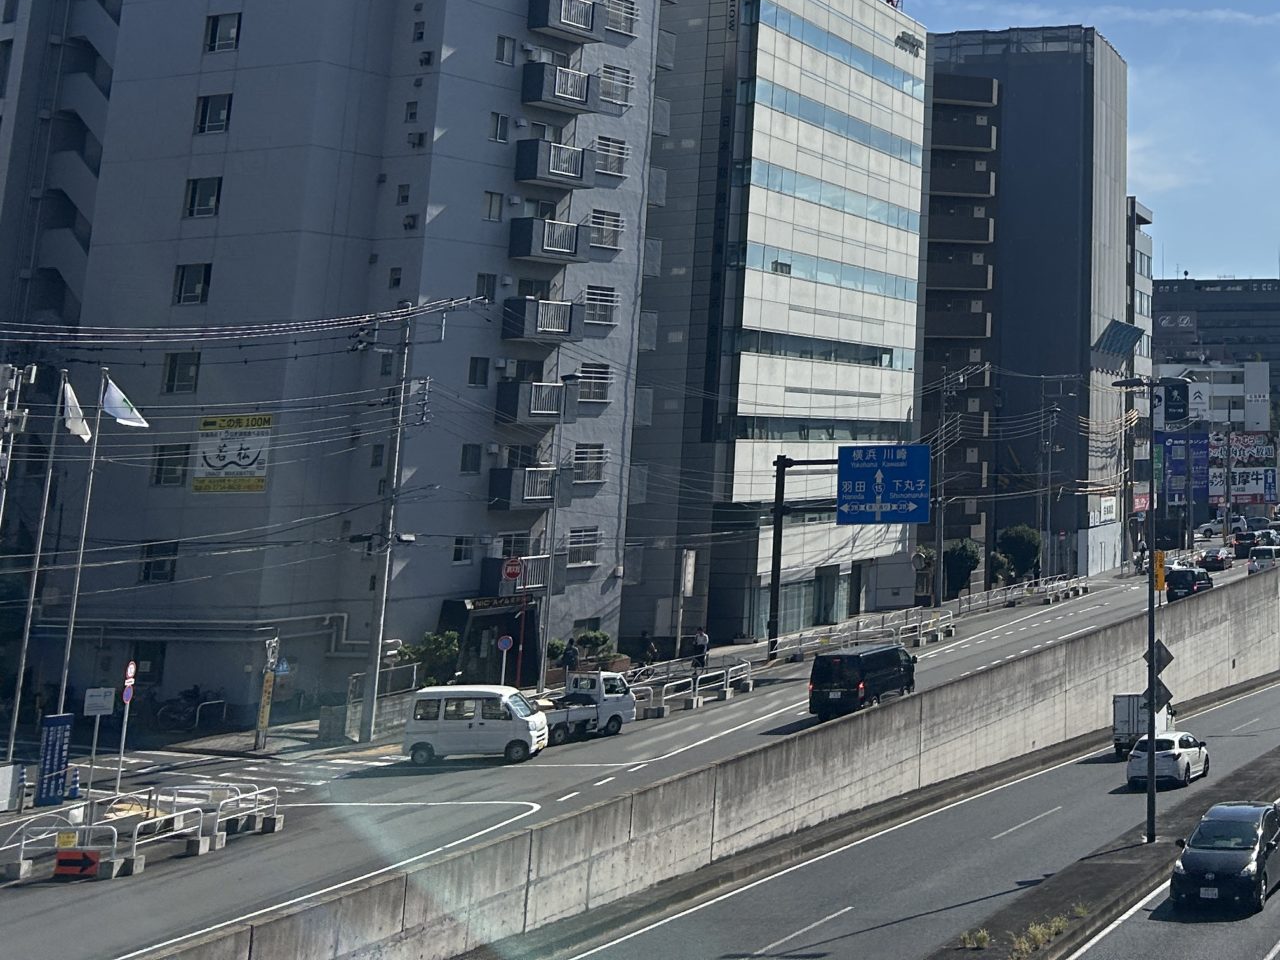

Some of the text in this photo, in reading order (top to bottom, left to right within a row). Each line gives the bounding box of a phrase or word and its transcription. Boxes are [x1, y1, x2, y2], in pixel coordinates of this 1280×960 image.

[853, 448, 907, 460] 横浜 川崎
[842, 481, 866, 493] 羽田
[892, 479, 926, 491] 下丸子
